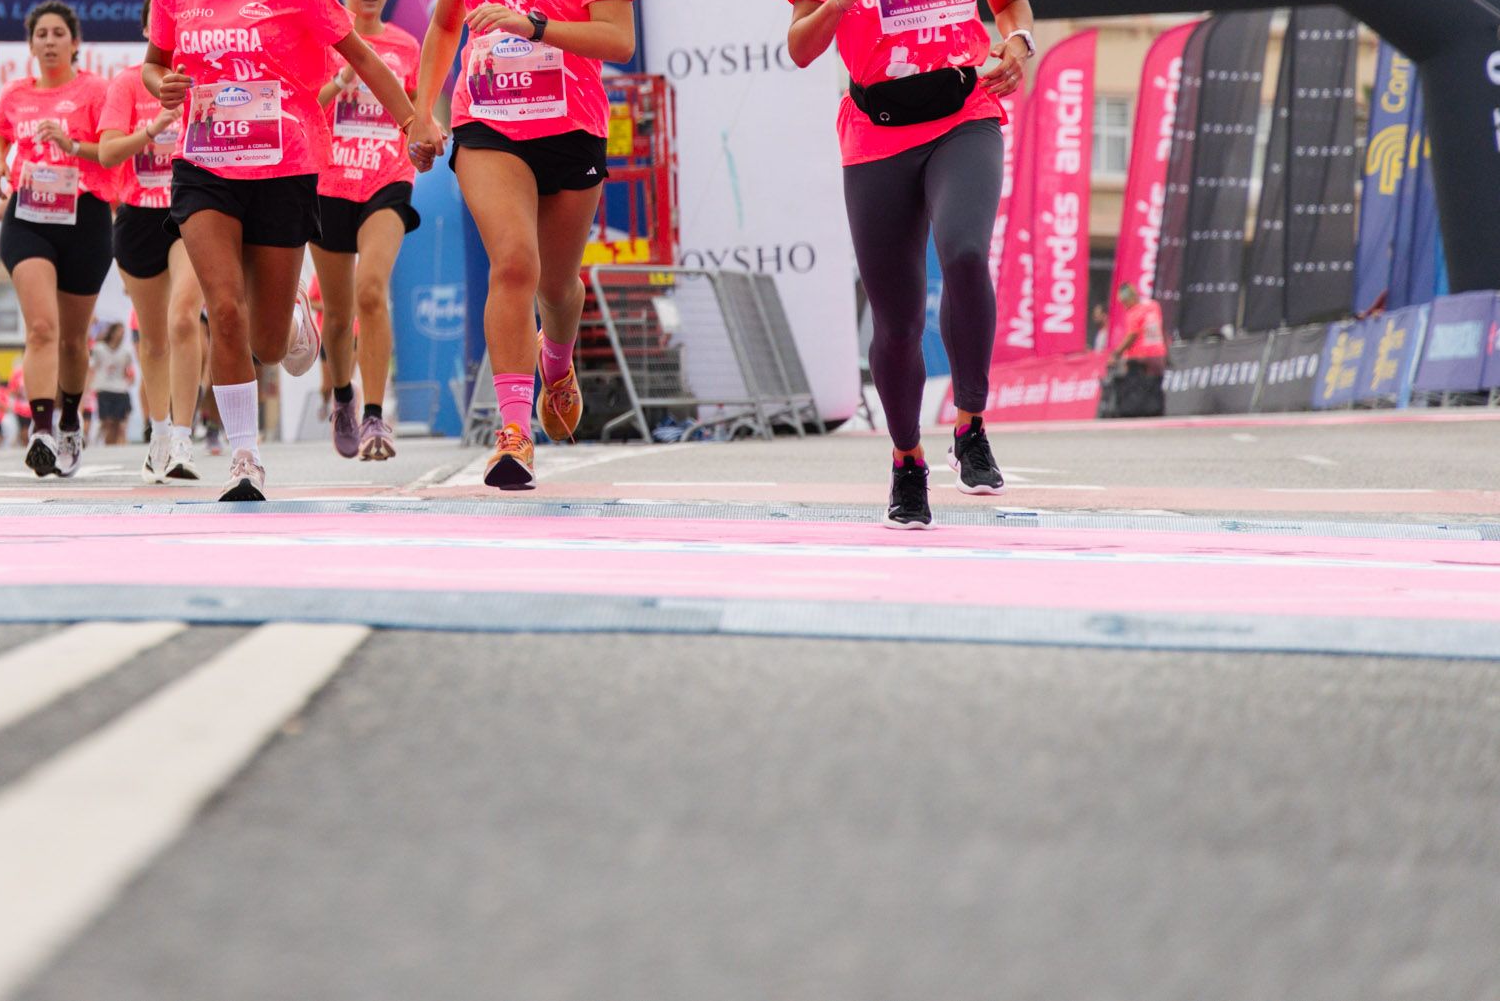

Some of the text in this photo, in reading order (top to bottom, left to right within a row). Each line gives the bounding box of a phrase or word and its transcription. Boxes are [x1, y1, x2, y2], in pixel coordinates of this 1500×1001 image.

[889, 6, 914, 16] CARRERA
[914, 4, 921, 12] DE
[893, 15, 927, 27] OYSHO
[180, 27, 263, 54] CARRERA
[495, 45, 531, 54] ASTURIANA
[668, 41, 798, 81] OYSHO
[495, 72, 533, 88] 016
[358, 104, 384, 116] 016
[526, 106, 556, 115] Santander
[213, 121, 250, 136] 016
[32, 190, 56, 204] 016
[1041, 67, 1085, 334] Nordés ancín
[681, 242, 817, 280] OYSHO
